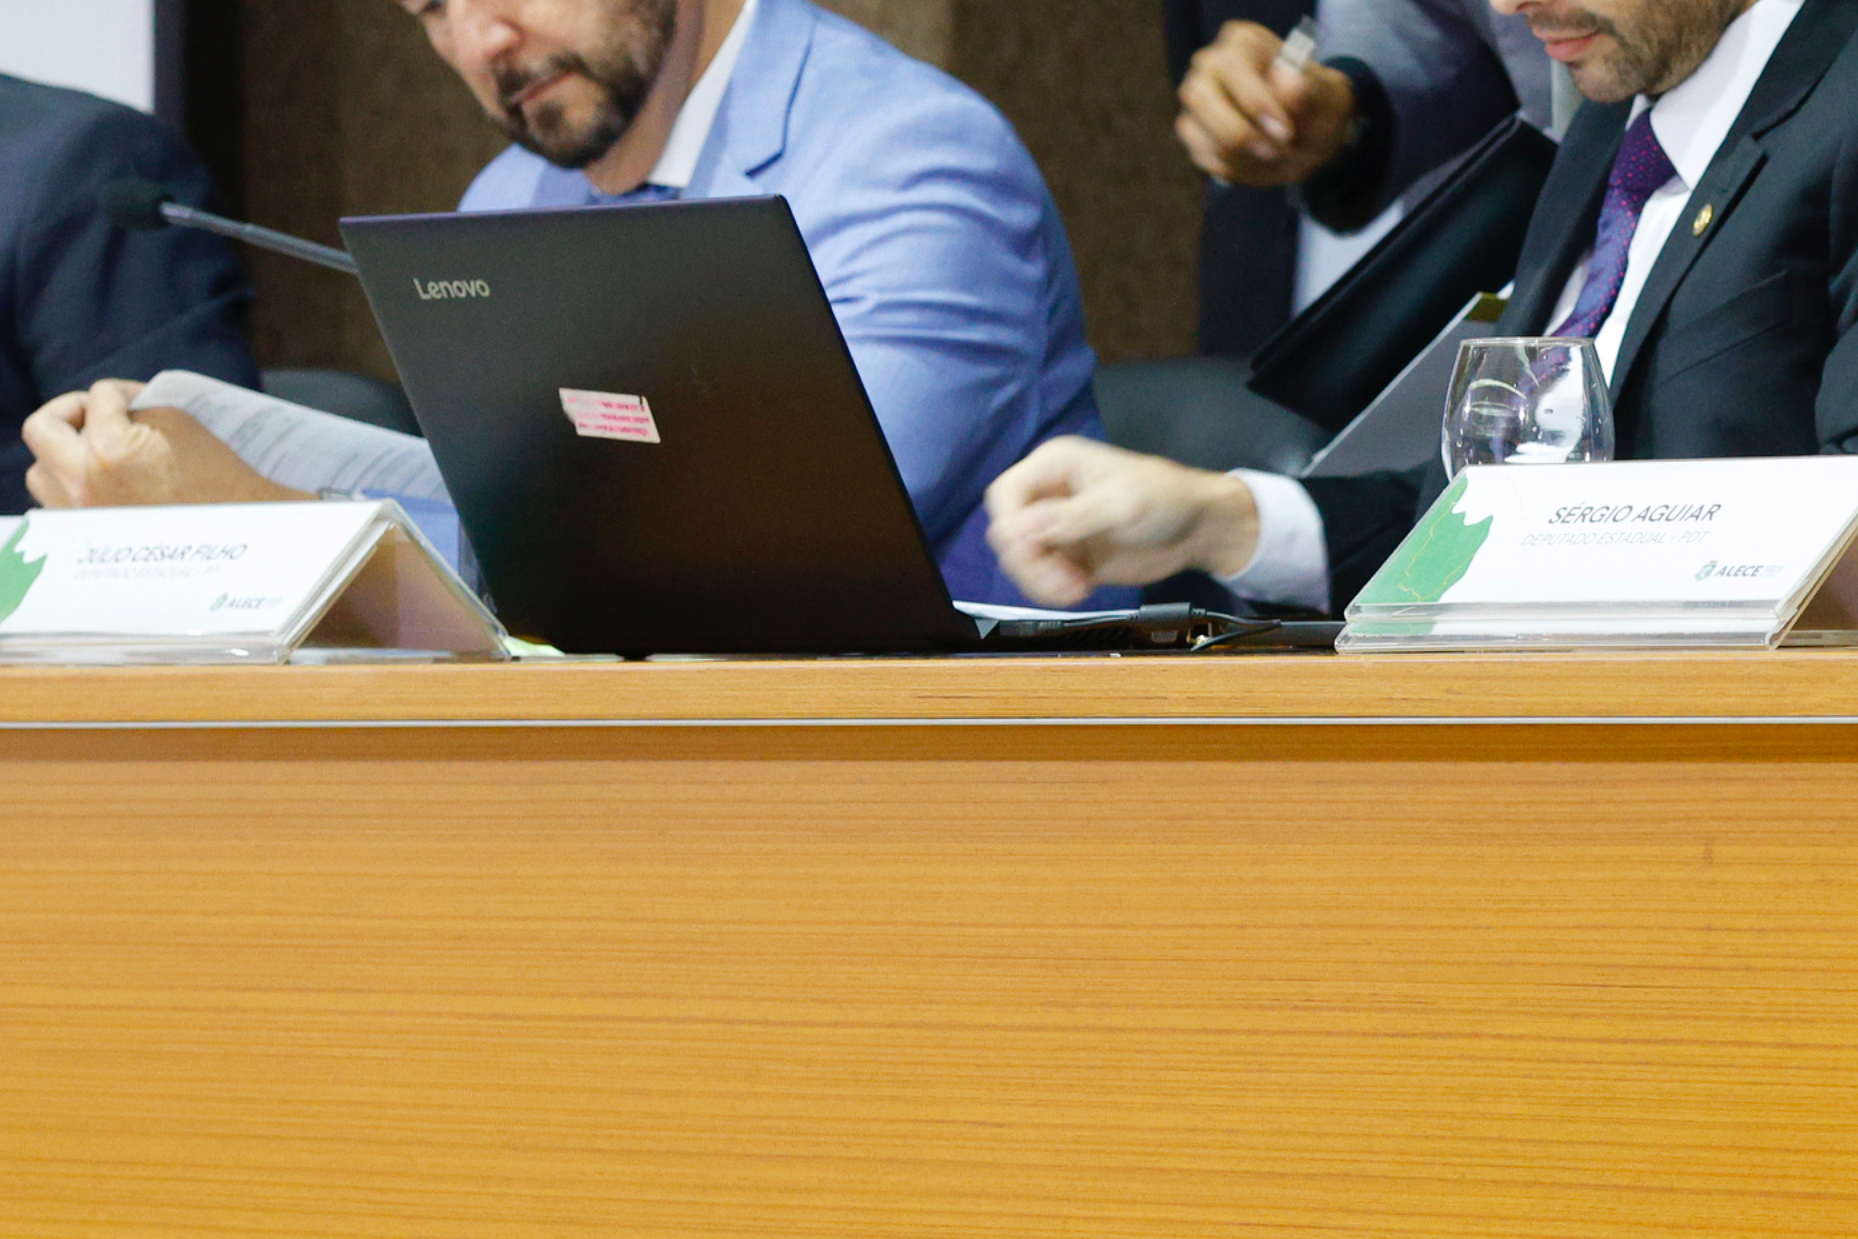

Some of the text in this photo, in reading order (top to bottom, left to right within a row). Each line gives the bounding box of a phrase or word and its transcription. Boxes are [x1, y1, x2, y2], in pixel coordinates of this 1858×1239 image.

[413, 278, 490, 300] Lenovo
[1548, 502, 1722, 524] SÉRGIO AGUIAR
[1520, 532, 1598, 547] DEPUTADO
[1598, 531, 1666, 545] ESTADUAL
[1677, 530, 1711, 544] PDT
[77, 542, 248, 563] JÚLIO CÉSAR FILHO
[1714, 565, 1764, 578] ALECE
[226, 597, 266, 609] ALECE
